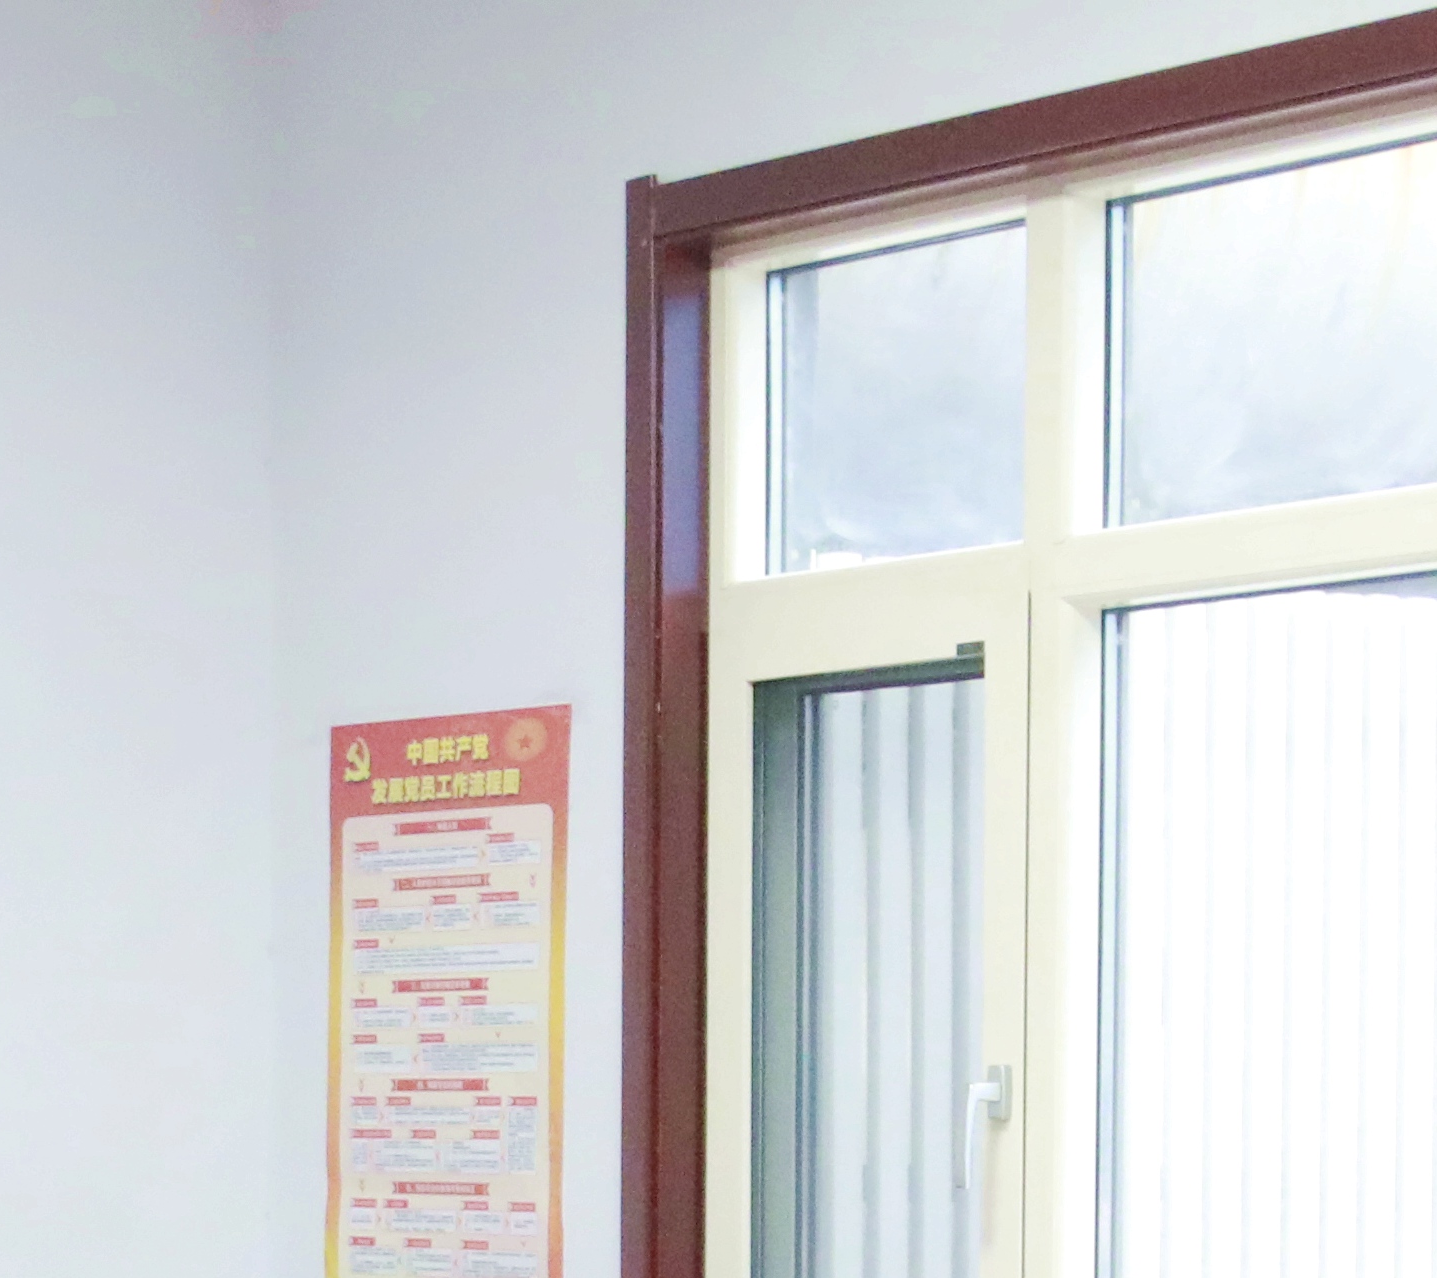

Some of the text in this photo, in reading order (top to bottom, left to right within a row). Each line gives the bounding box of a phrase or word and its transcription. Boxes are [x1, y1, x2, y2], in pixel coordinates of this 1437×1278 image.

[406, 733, 490, 766] 中国共产党
